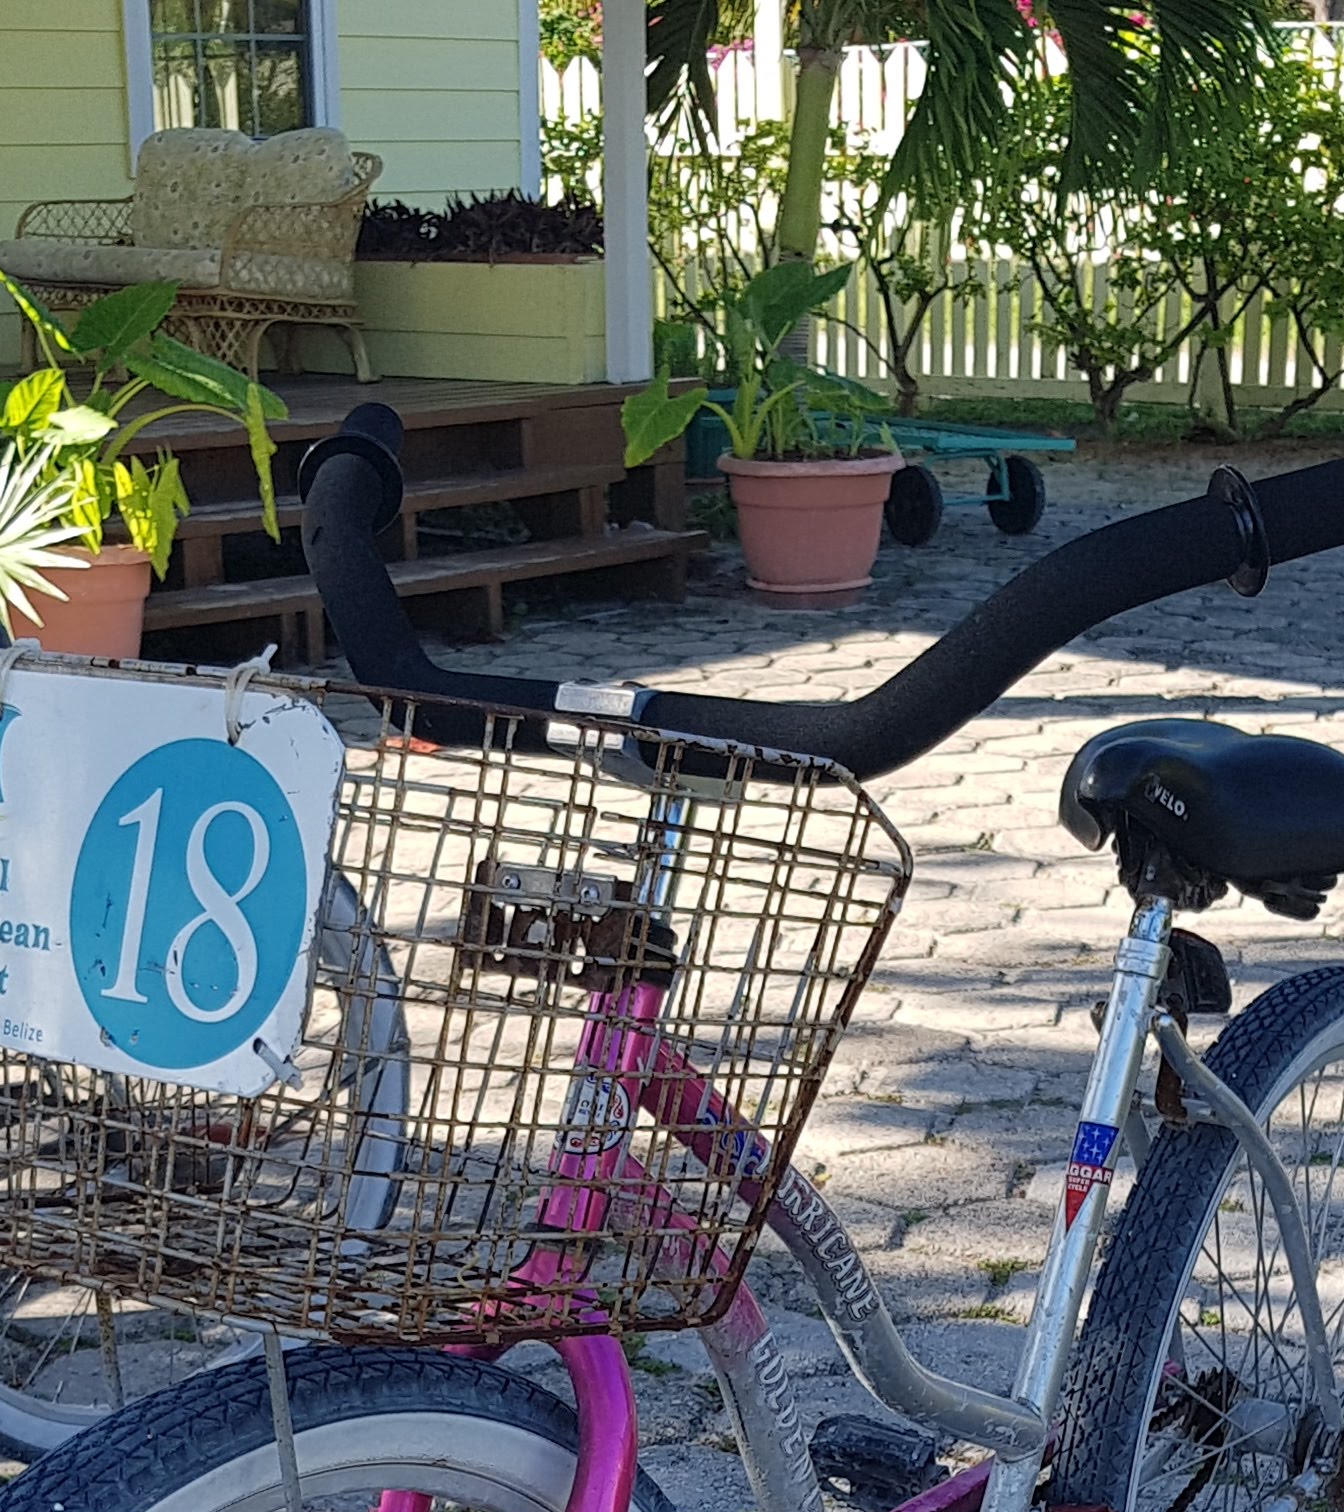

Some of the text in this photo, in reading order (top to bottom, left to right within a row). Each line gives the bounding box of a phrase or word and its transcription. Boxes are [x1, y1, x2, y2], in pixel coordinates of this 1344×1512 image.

[1154, 783, 1186, 817] VELO
[100, 787, 271, 1023] 18
[3, 1019, 44, 1043] Belize
